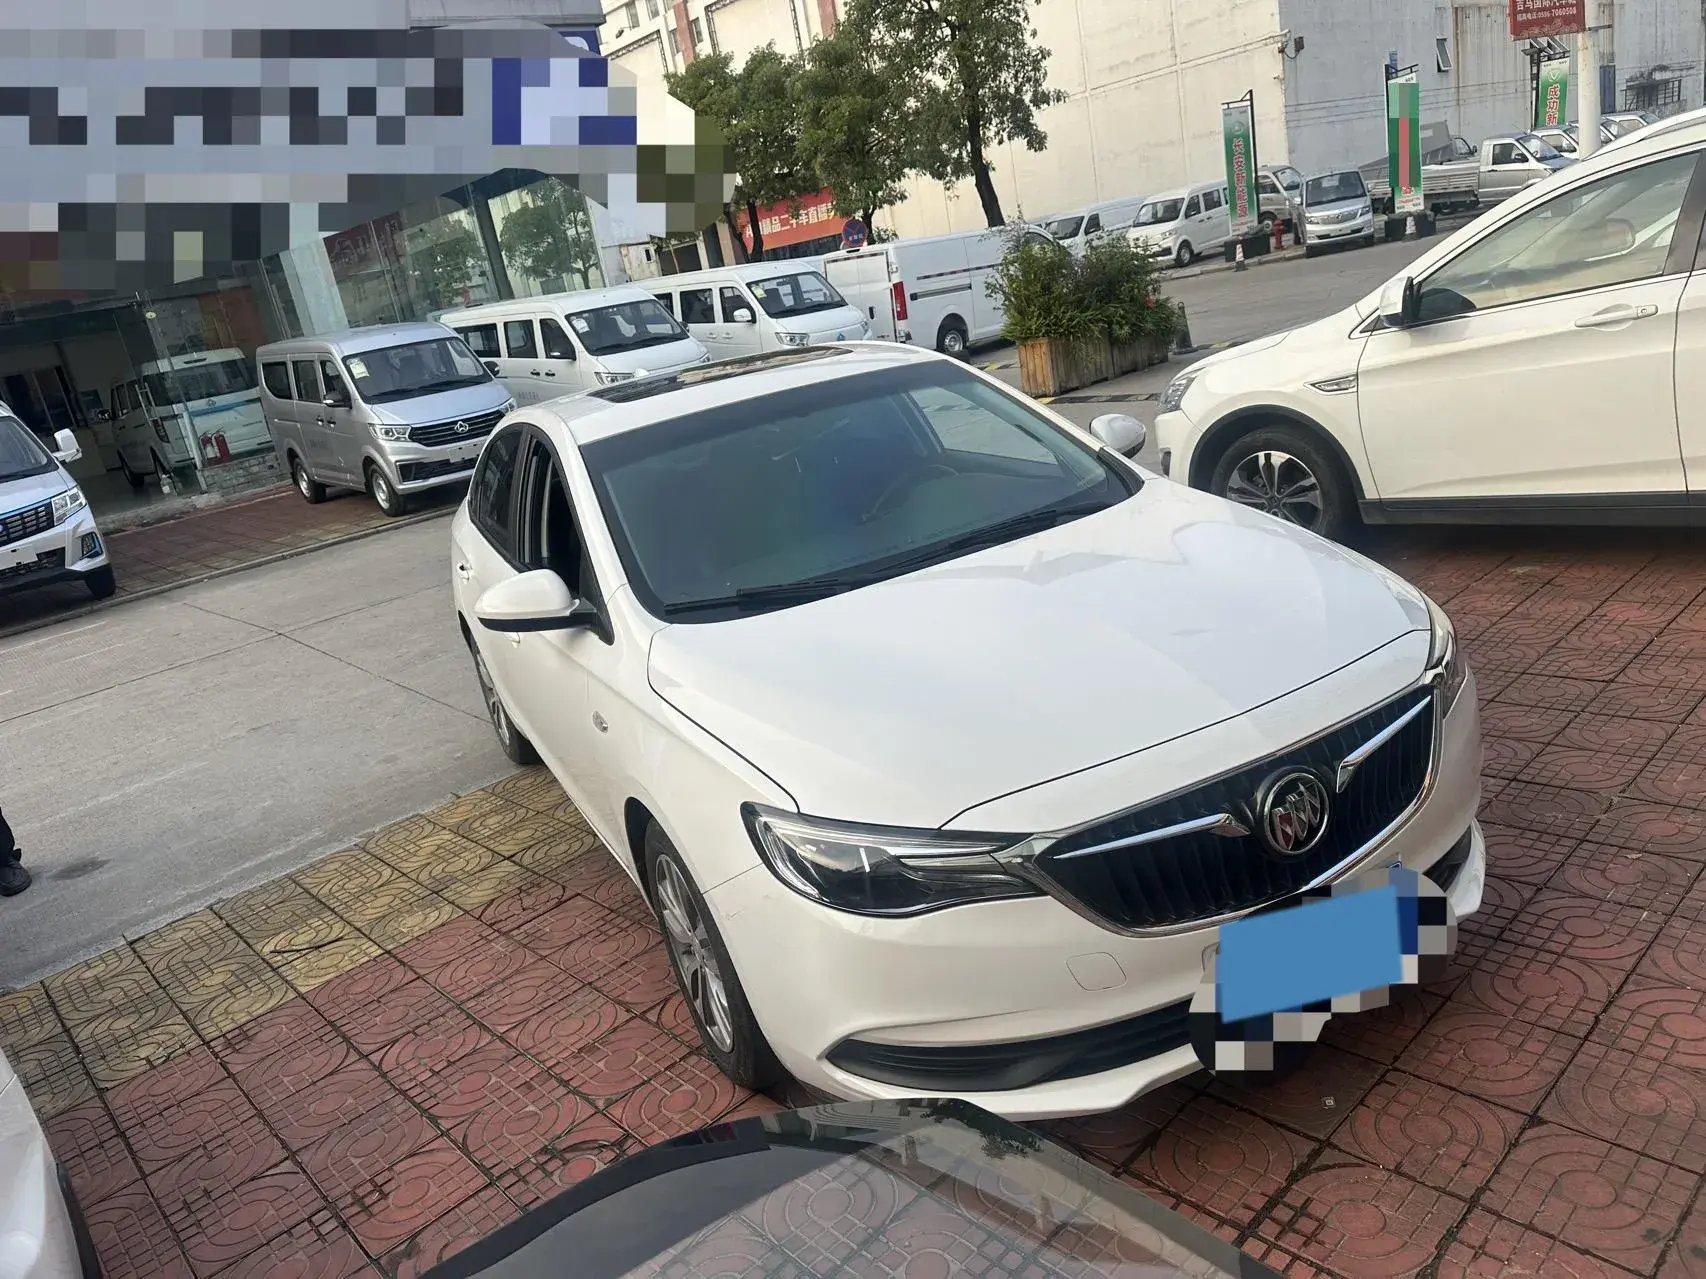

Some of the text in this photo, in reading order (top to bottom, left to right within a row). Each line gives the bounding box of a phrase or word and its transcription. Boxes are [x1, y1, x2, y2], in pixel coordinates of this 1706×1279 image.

[1232, 137, 1249, 218] 长安新能源
